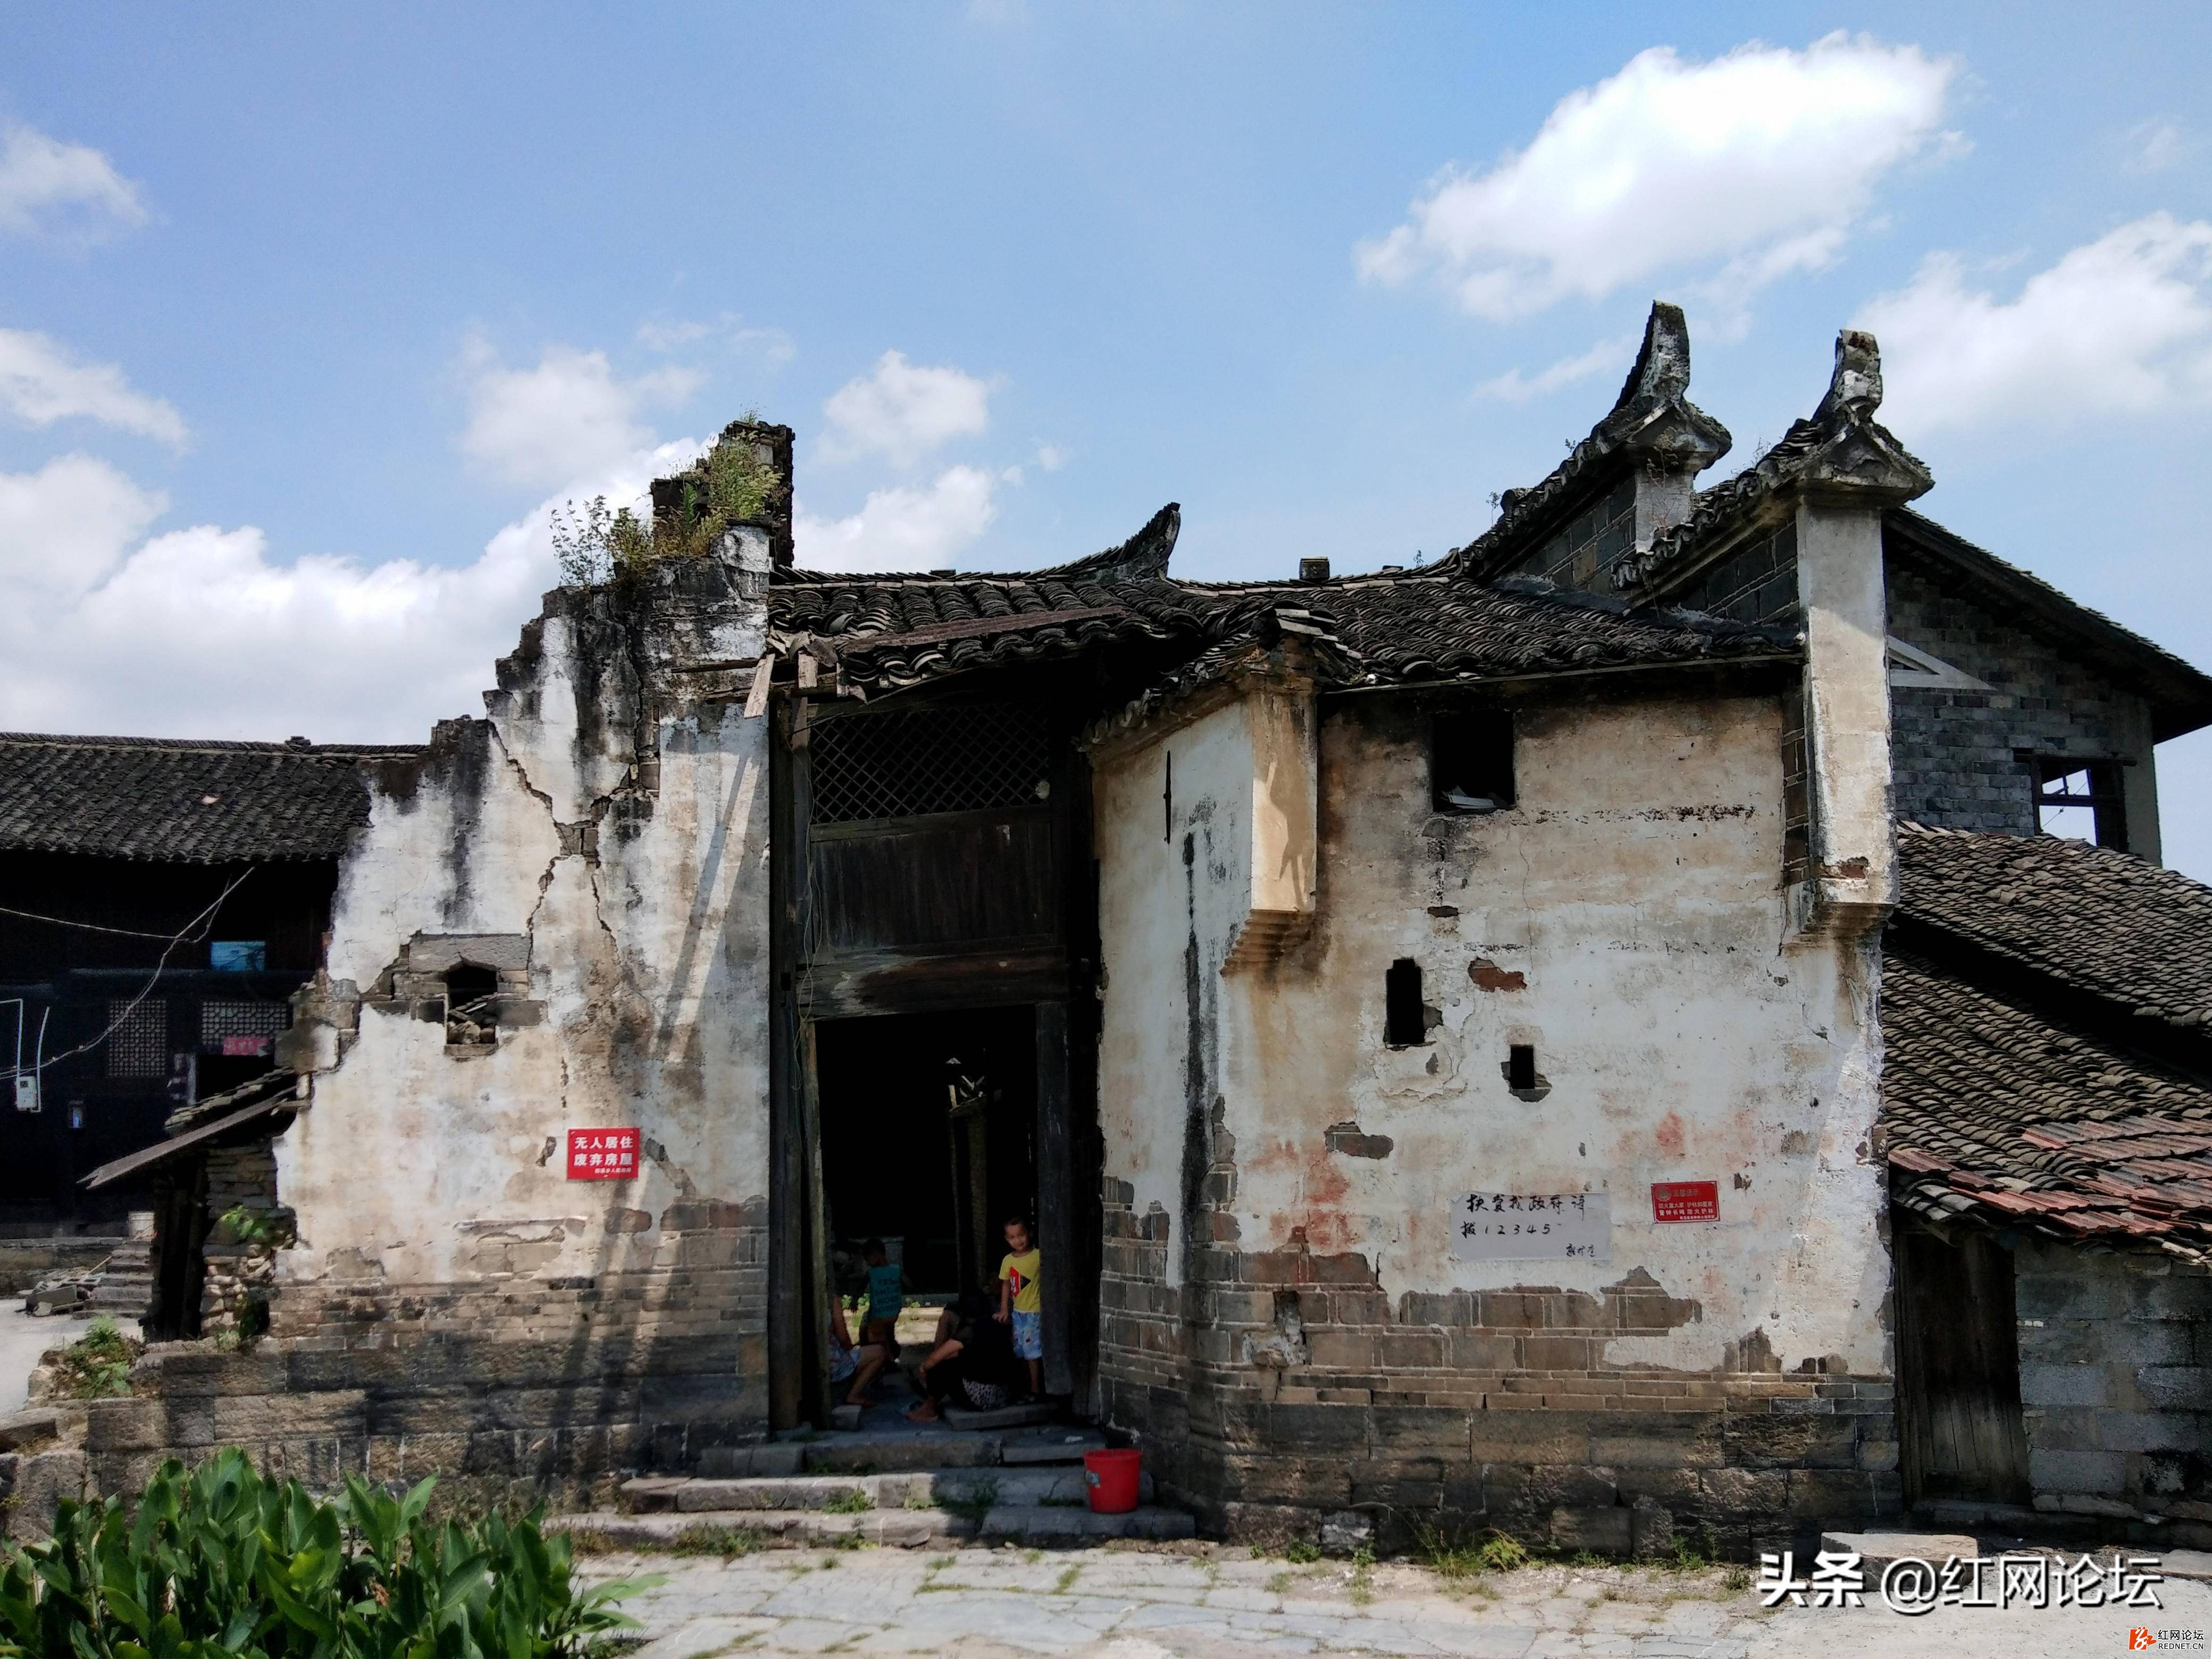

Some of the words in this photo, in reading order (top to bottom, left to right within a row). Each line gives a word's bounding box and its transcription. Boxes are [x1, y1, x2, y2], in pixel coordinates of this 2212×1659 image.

[574, 1136, 634, 1150] 无人居住
[574, 1153, 633, 1166] 废弃房屋
